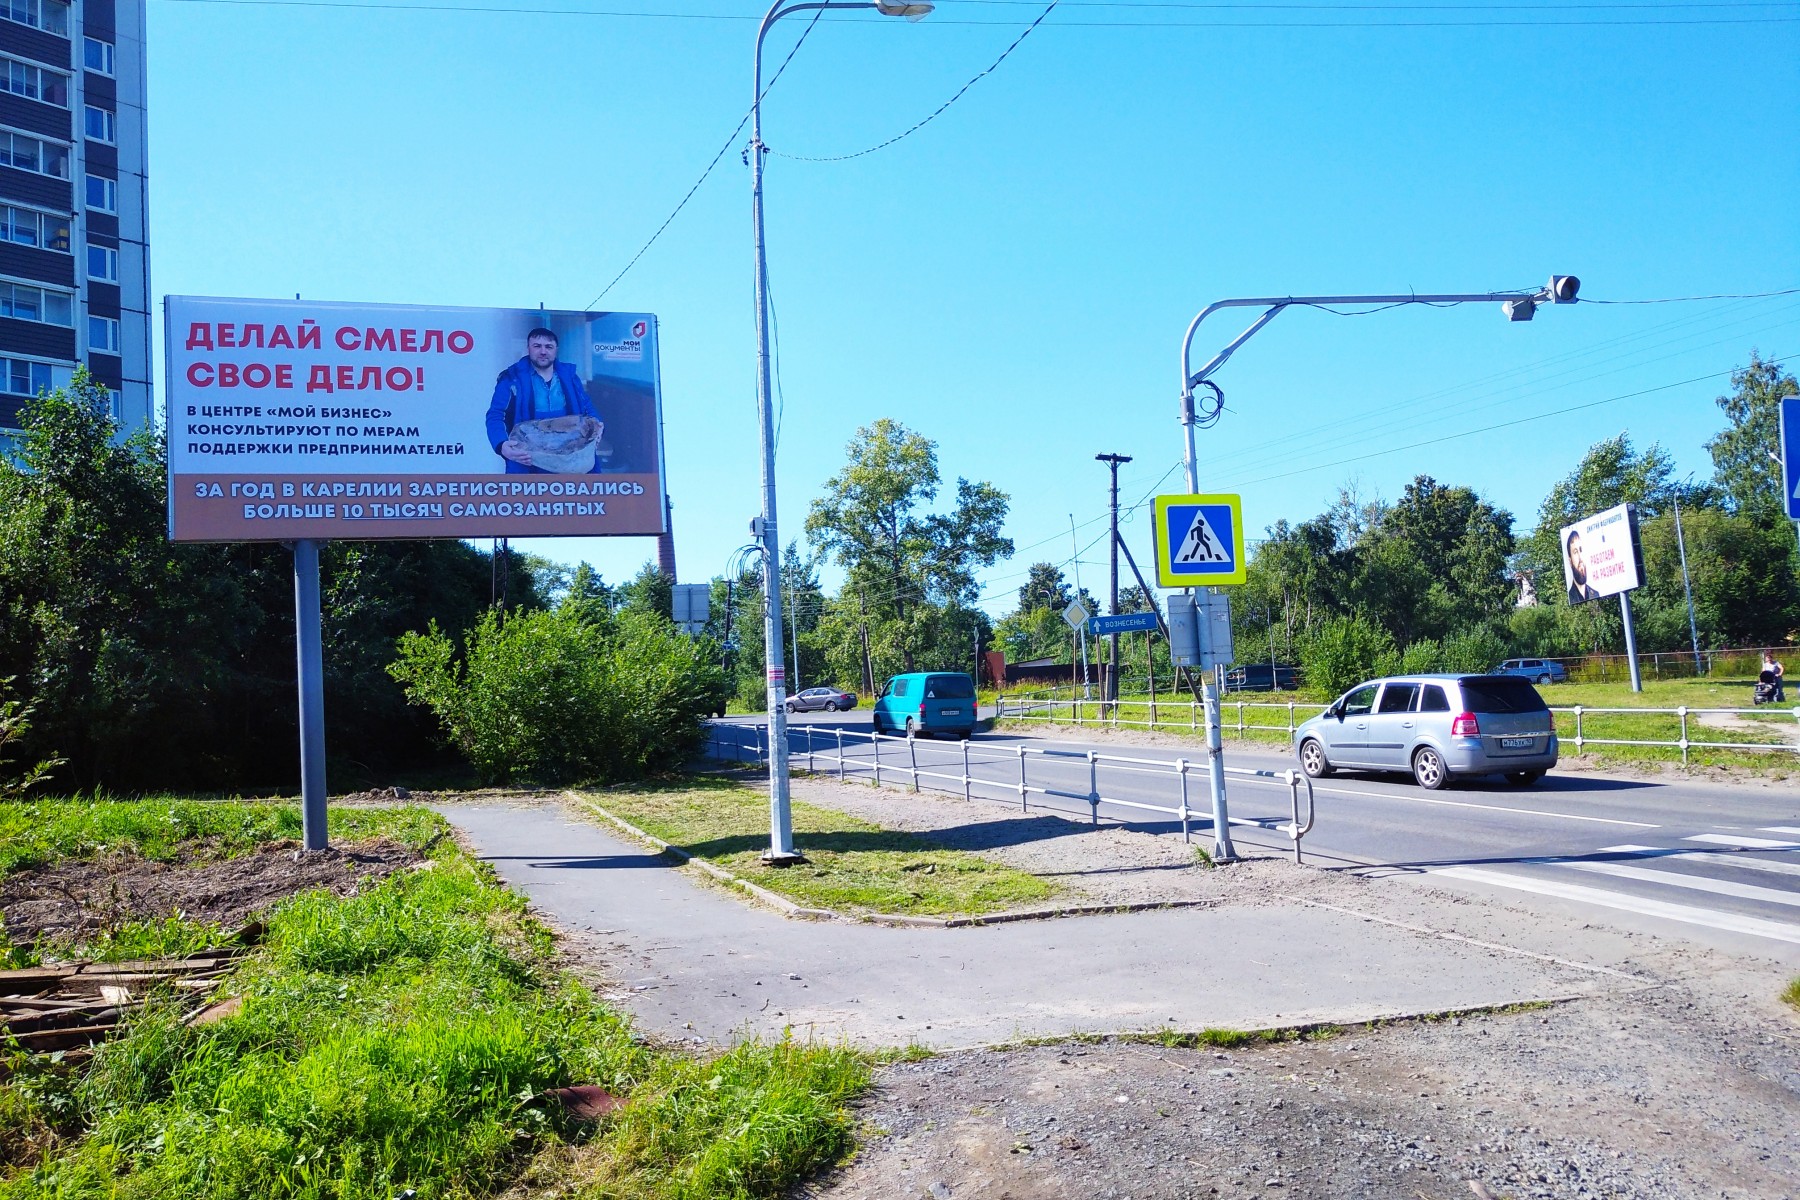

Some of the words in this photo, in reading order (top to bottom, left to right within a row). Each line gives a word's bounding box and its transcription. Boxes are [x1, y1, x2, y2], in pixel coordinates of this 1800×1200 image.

[186, 319, 322, 351] ДЕЛАЙ
[335, 326, 474, 354] СМЕЛО
[186, 361, 294, 389] СВОЕ
[306, 365, 424, 393] ДЕЛО!
[187, 405, 197, 417] В
[201, 406, 262, 418] ЦЕНТРЕ
[267, 404, 316, 418] «МОЙ
[321, 407, 392, 419] БИЗНЕС»
[187, 424, 331, 436] КОНСУЛЬТИРУЮТ
[336, 426, 359, 437] ПО
[363, 426, 420, 437] МЕРАМ
[188, 442, 293, 455] ПОДДЕРЖКИ
[298, 442, 465, 456] ПРЕДПРИНИМАТЕЛЕЙ
[195, 482, 224, 497] ЗА
[231, 482, 275, 499] ГОД
[282, 482, 295, 497] В
[302, 482, 402, 497] КАРЕЛИИ
[409, 481, 644, 497] ЗАРЕГИСТРИРОВАЛИСЬ
[244, 504, 336, 519] БОЛЬШЕ
[342, 504, 363, 518] 10
[369, 503, 443, 518] ТЫСЯЧ
[450, 502, 606, 517] САМОЗАНЯТЫХ
[1590, 548, 1615, 565] РАБОТАЕМ
[1592, 569, 1600, 581] НА
[1600, 561, 1625, 579] РАЗВИТИЕ
[1105, 618, 1146, 628] ВОЗНЕСЕНЬЕ
